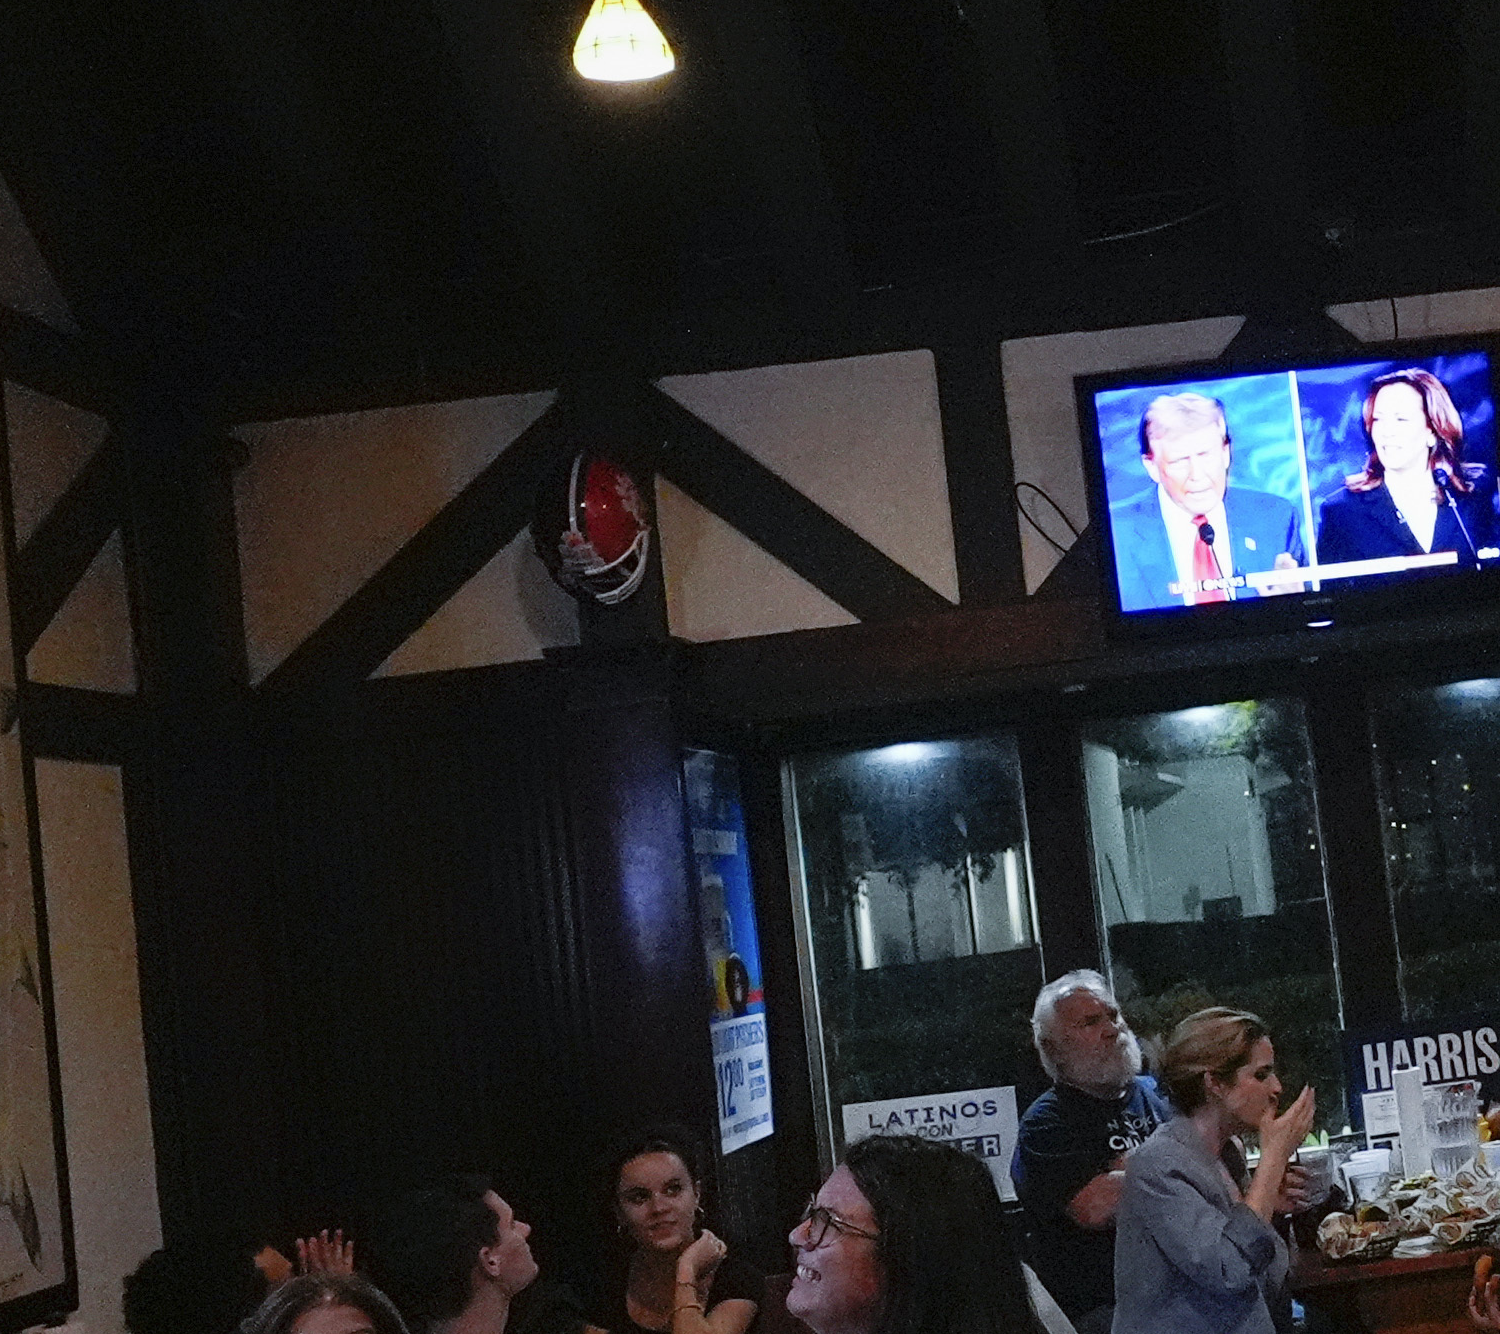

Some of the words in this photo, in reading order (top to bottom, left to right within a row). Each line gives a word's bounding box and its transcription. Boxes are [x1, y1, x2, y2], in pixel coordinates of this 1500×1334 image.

[1362, 1027, 1500, 1090] HARRIS
[868, 1099, 999, 1130] LATINOS
[918, 1123, 954, 1138] CON
